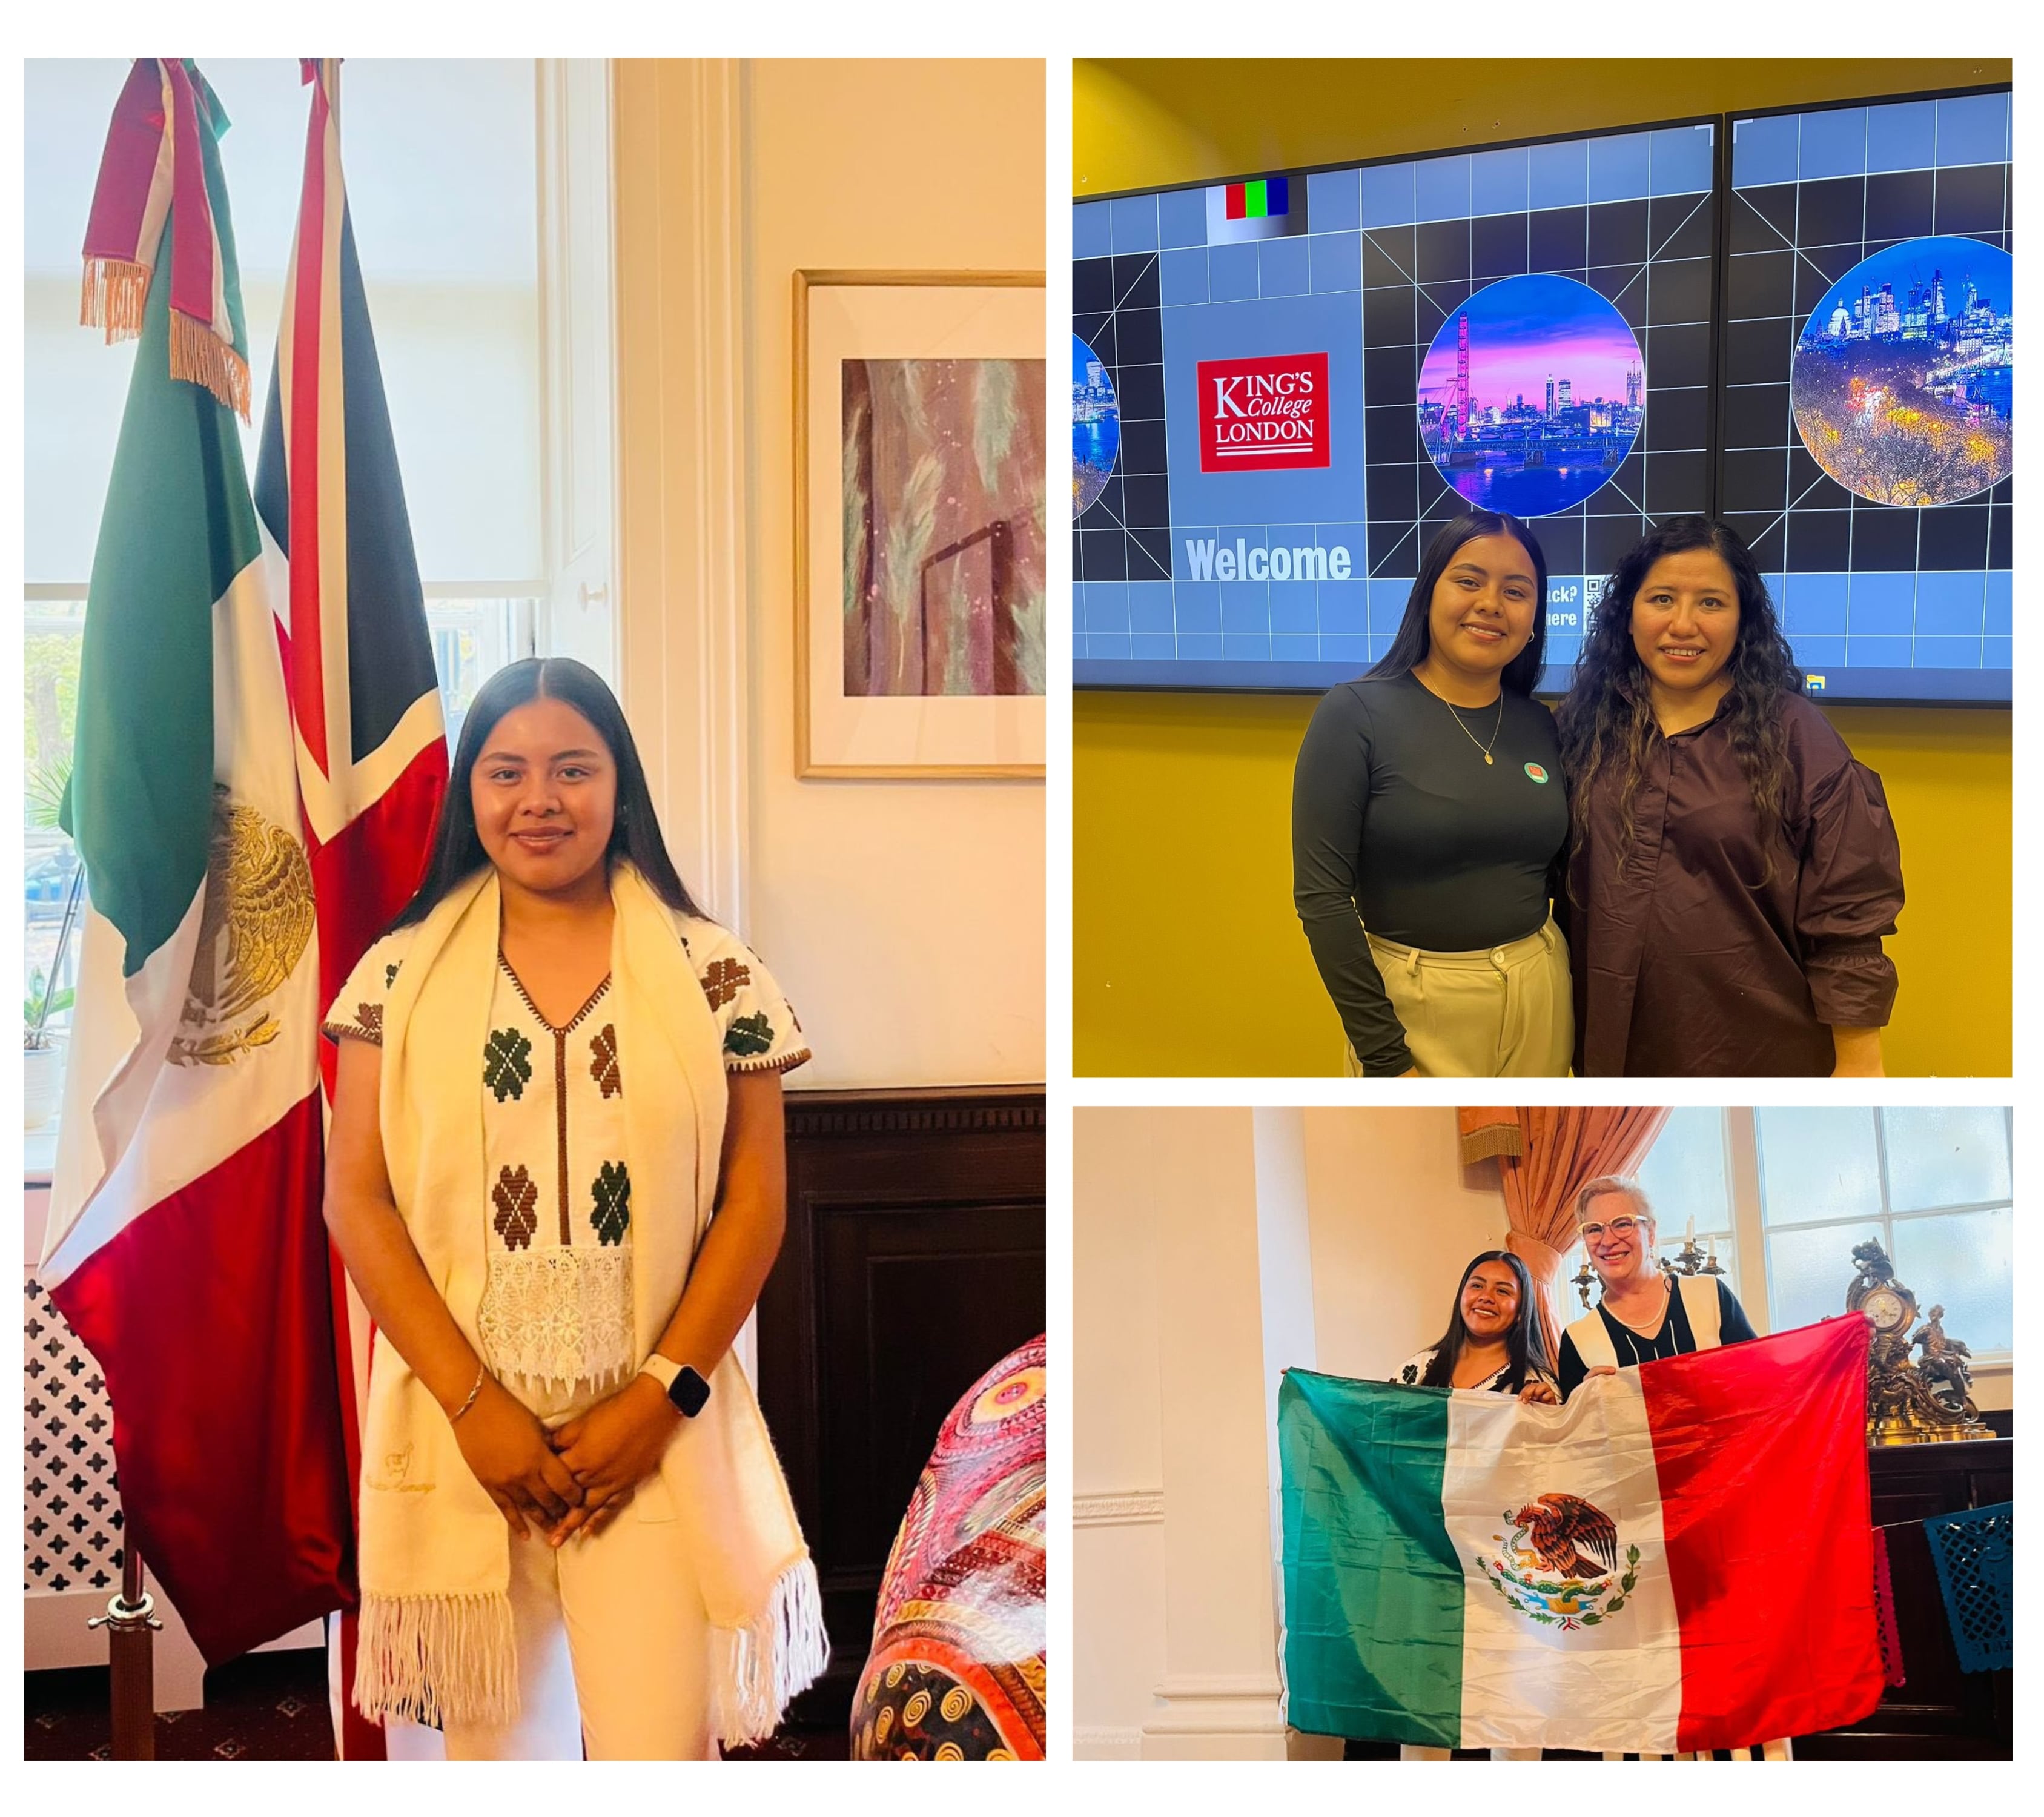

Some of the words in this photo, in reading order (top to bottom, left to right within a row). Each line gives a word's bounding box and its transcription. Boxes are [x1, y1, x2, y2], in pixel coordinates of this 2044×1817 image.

[1212, 371, 1314, 419] KING’S
[1248, 396, 1312, 418] College
[1215, 419, 1314, 443] LONDON
[1185, 538, 1351, 580] Welcome
